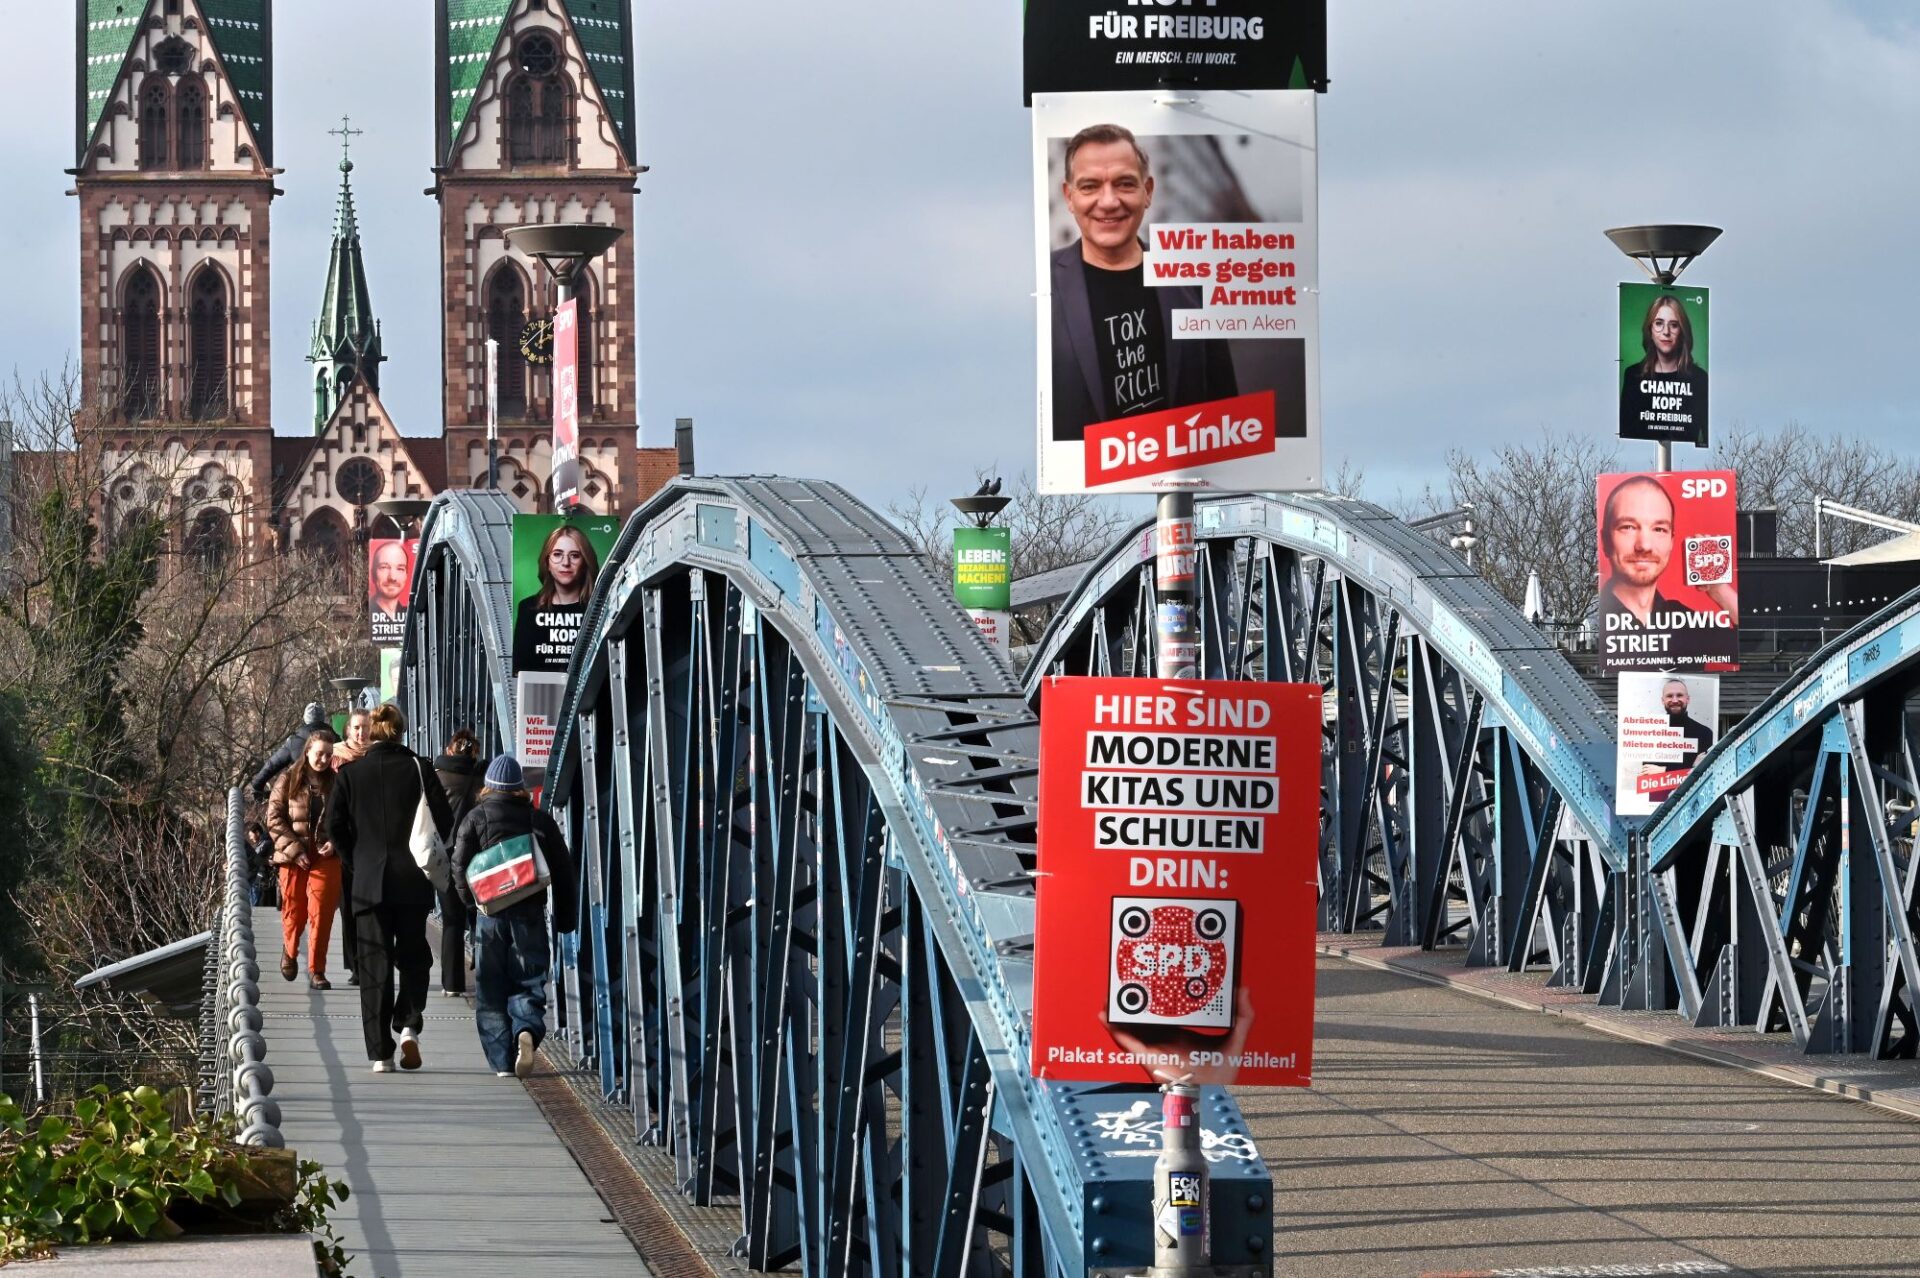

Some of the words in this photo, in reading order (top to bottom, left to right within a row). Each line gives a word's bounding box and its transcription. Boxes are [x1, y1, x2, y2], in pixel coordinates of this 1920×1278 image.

[1089, 11, 1138, 39] FÜR
[1144, 15, 1264, 40] FREIBURG
[1115, 52, 1134, 64] EIN
[1135, 52, 1183, 64] MENSCH.
[1185, 52, 1203, 64] EIN
[1205, 53, 1237, 65] WORT.
[1157, 228, 1207, 250] Wir
[1212, 229, 1295, 250] haben
[1153, 262, 1211, 278] was
[1216, 257, 1296, 283] gegen
[1210, 285, 1297, 306] Armut
[1179, 316, 1211, 332] Jan
[1216, 319, 1247, 332] van
[1252, 314, 1296, 332] Aken
[1116, 344, 1145, 369] the
[1640, 380, 1693, 396] CHANTAL
[1652, 396, 1683, 410] KOPF
[1640, 410, 1656, 421] FÜR
[1656, 412, 1693, 423] FREIBURG
[1100, 431, 1160, 471] Die
[1681, 479, 1728, 499] SPD
[957, 549, 1006, 564] LEBEN:
[1694, 554, 1724, 567] SPD
[957, 573, 1006, 584] MACHEN!
[372, 612, 389, 623] DR.
[392, 612, 407, 622] LU
[535, 612, 584, 627] CHANT
[1605, 613, 1640, 631] DR.
[1646, 610, 1731, 630] LUDWIG
[372, 624, 405, 634] STRIET
[535, 643, 554, 654] FÜR
[1605, 634, 1672, 653] STRIET
[1606, 658, 1635, 666] PLAKAT
[1636, 656, 1676, 665] SCANNEN,
[1677, 655, 1693, 664] SPD
[1694, 654, 1731, 664] WÄHLEN!
[1095, 695, 1177, 726] HIER
[1187, 699, 1271, 728] SIND
[526, 716, 545, 725] Wir
[1623, 716, 1668, 725] Abrüsten.
[1623, 728, 1681, 737] Umverteilen.
[526, 738, 544, 746] uns
[1622, 740, 1655, 749] Mieten
[1656, 741, 1696, 750] deckeln.
[526, 747, 552, 756] Fami
[1090, 736, 1272, 769] MODERNE
[1641, 778, 1659, 790] Die
[1087, 775, 1185, 807] KITAS
[1195, 779, 1274, 809] UND
[1099, 816, 1260, 849] SCHULEN
[1130, 857, 1229, 889] DRIN:
[1132, 944, 1212, 977] SPD
[1048, 1047, 1104, 1063] Plakat
[1108, 1051, 1185, 1069] scannen,
[1188, 1051, 1224, 1066] SPD
[1228, 1052, 1297, 1069] wählen!
[1171, 1177, 1200, 1191] FCK
[1171, 1188, 1200, 1202] PTN
